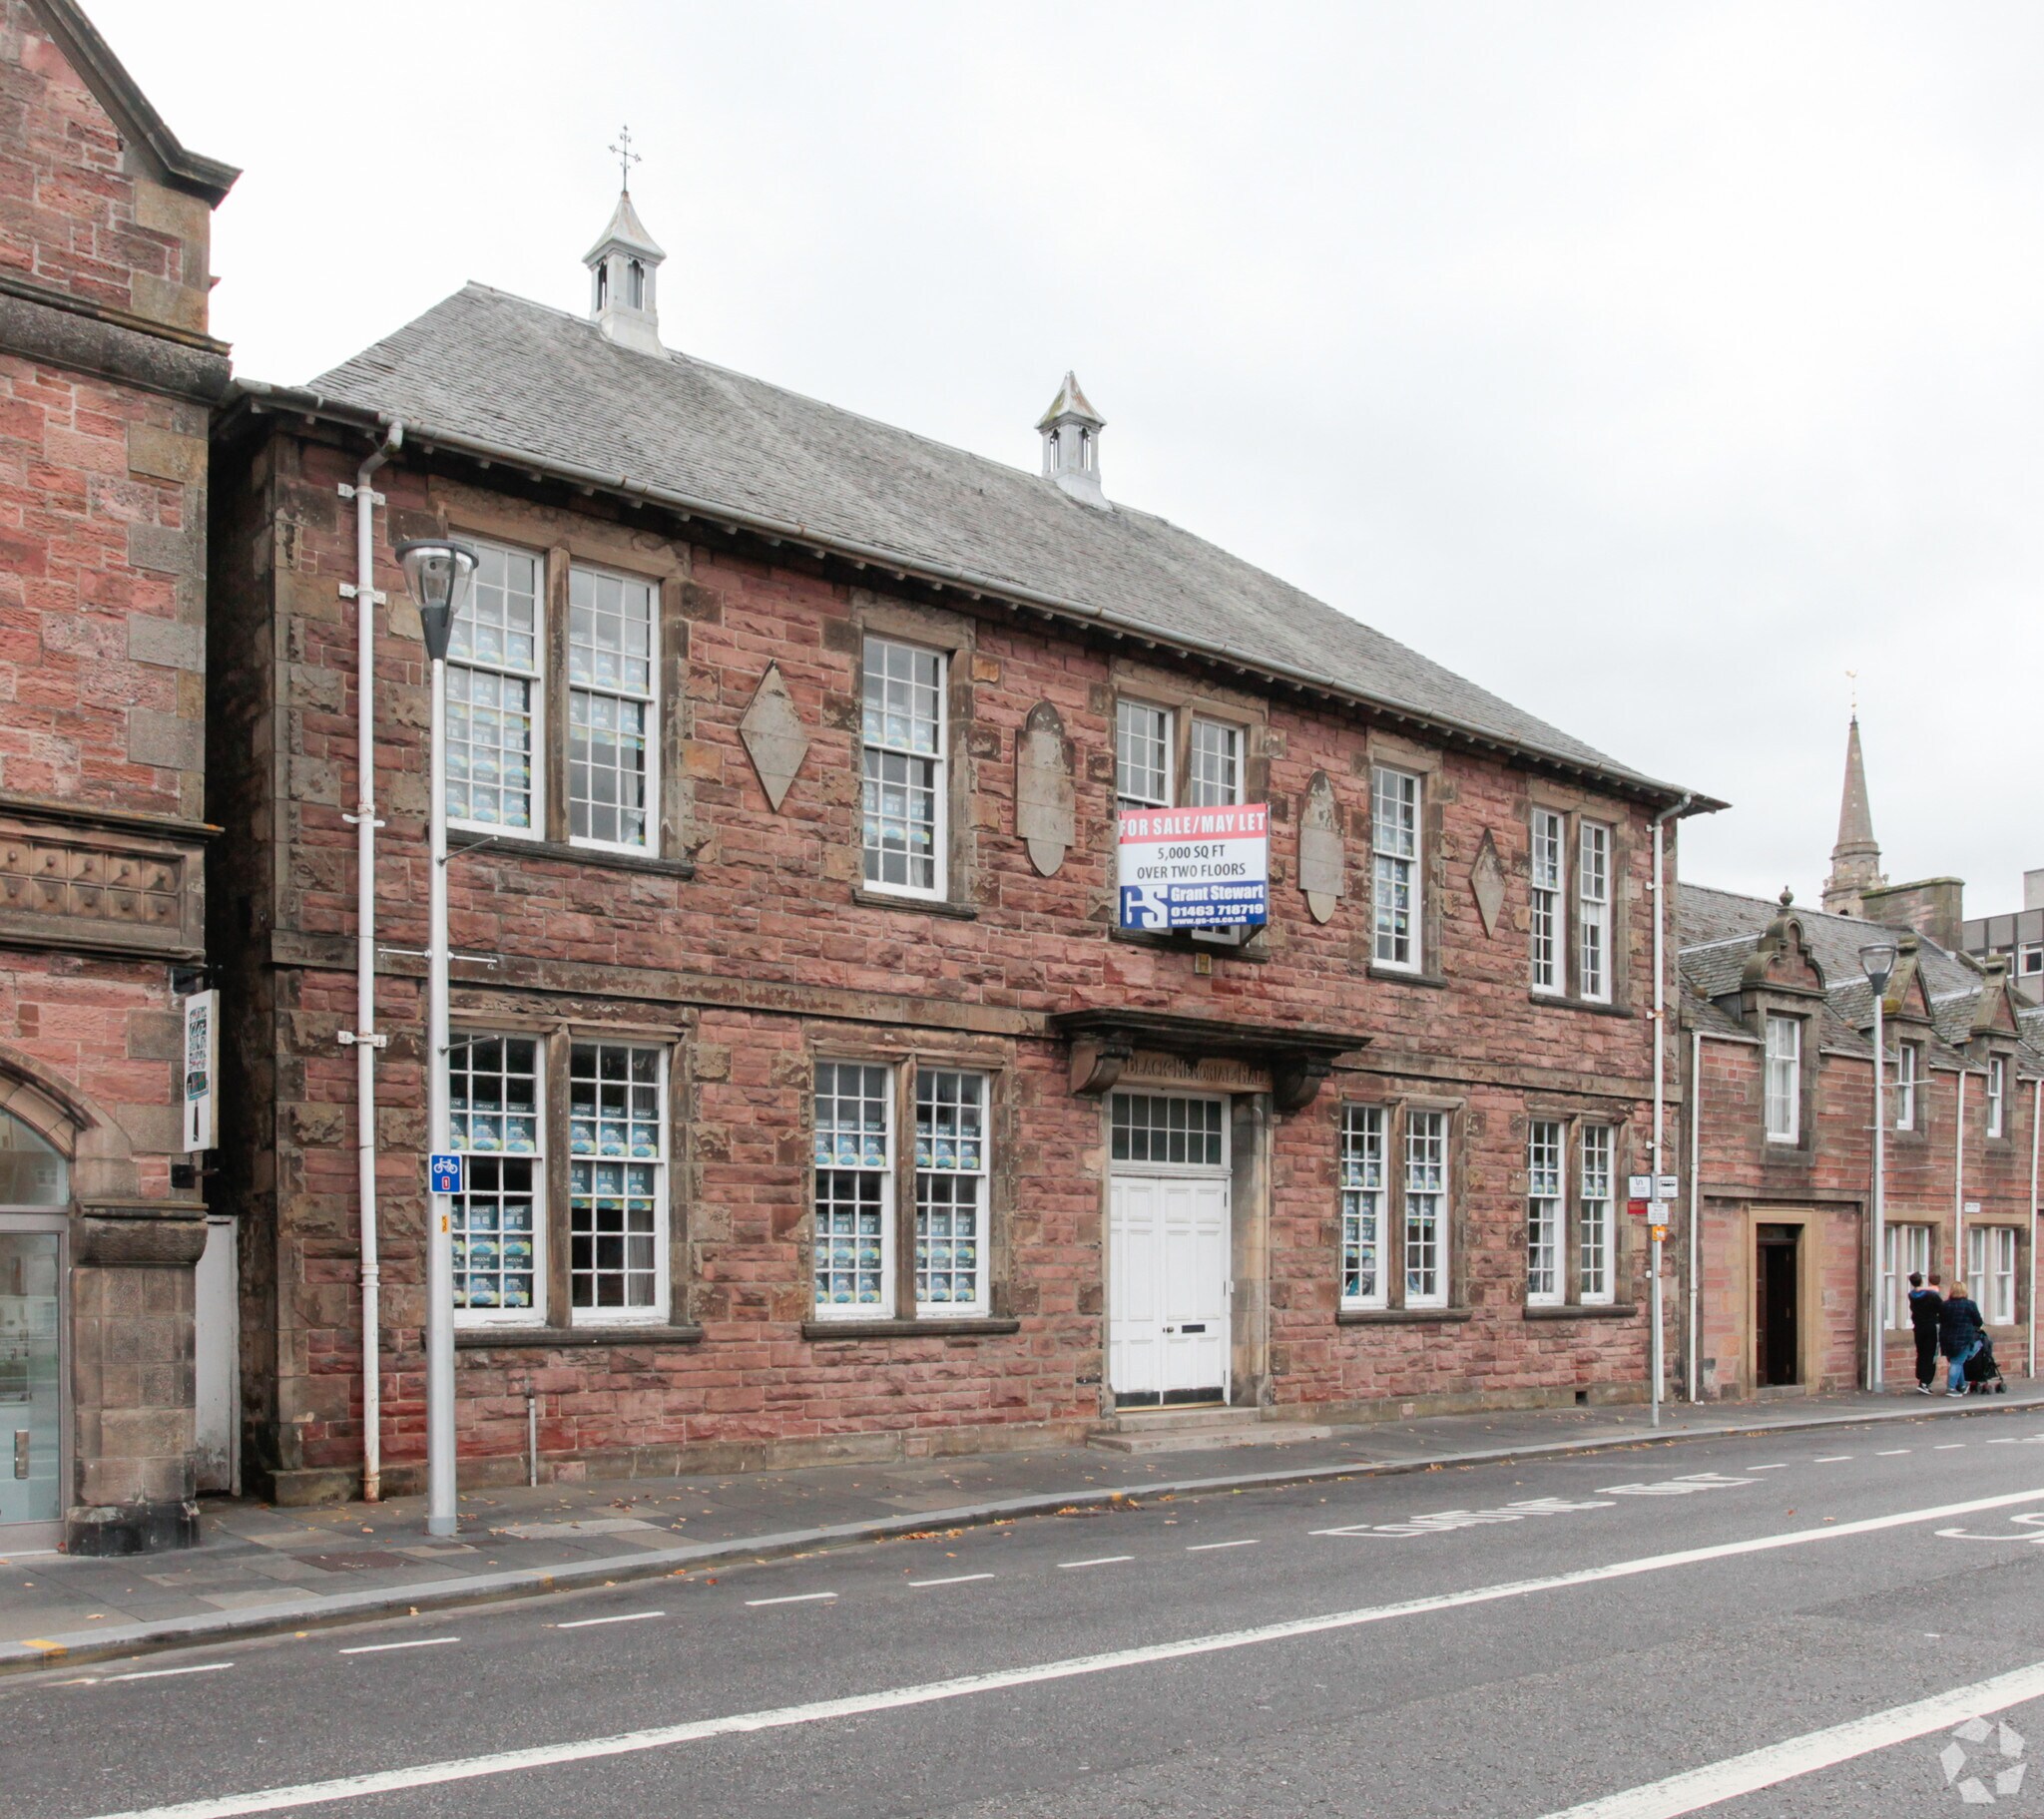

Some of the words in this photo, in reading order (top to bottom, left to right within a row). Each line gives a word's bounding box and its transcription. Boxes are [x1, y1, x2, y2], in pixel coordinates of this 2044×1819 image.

[1120, 818, 1149, 837] FOR
[1153, 814, 1235, 835] SALE/MAY
[1238, 811, 1266, 832] LET
[1157, 846, 1191, 861] 5,000
[1194, 845, 1210, 859] SQ
[1212, 844, 1226, 857] FT
[1137, 866, 1169, 879] OVER
[1171, 864, 1198, 878] TWO
[1201, 863, 1246, 877] FLOORS
[1171, 885, 1209, 902] Grant
[1210, 884, 1265, 900] Stewart
[1171, 905, 1215, 917] 01463
[1217, 903, 1265, 916] 718719
